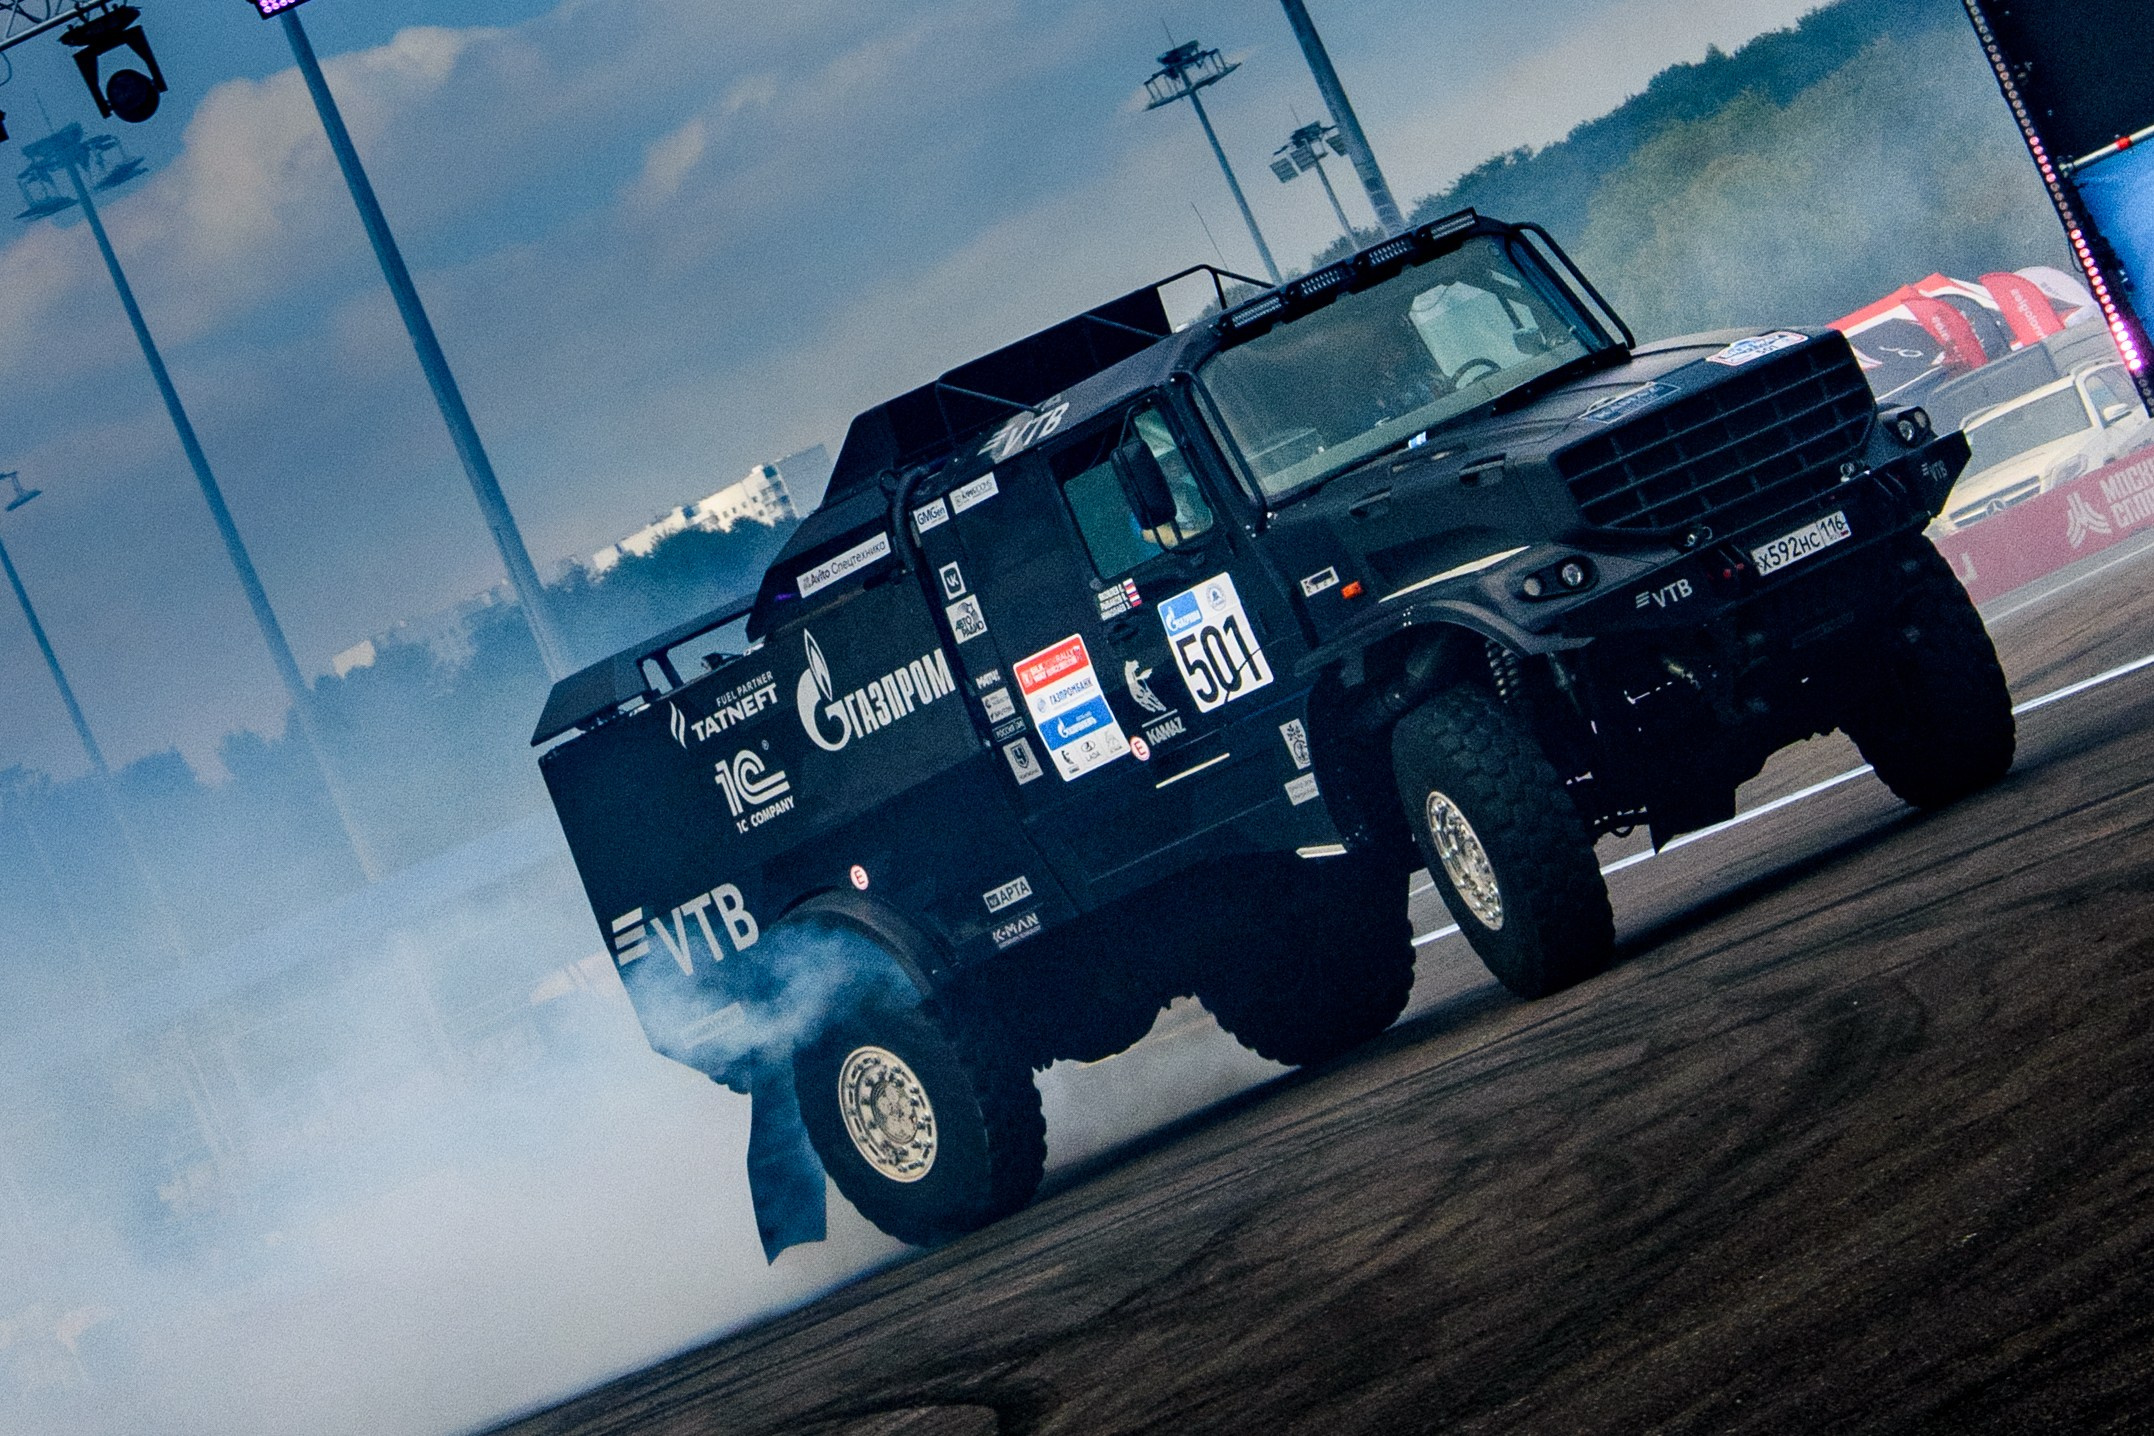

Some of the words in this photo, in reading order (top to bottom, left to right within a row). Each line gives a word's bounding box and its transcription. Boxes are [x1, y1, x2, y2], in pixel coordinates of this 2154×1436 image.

[1002, 402, 1070, 456] VTB
[811, 567, 831, 587] Avito
[831, 540, 886, 576] Спецтехника
[1651, 578, 1694, 608] VTB
[1175, 614, 1262, 704] 501
[691, 682, 778, 742] TATNEFT
[716, 687, 737, 707] FUEL
[737, 670, 774, 696] PARTNER
[843, 647, 956, 739] ГАЗПРОМ
[750, 796, 795, 829] COMPANY
[650, 883, 760, 977] VTB
